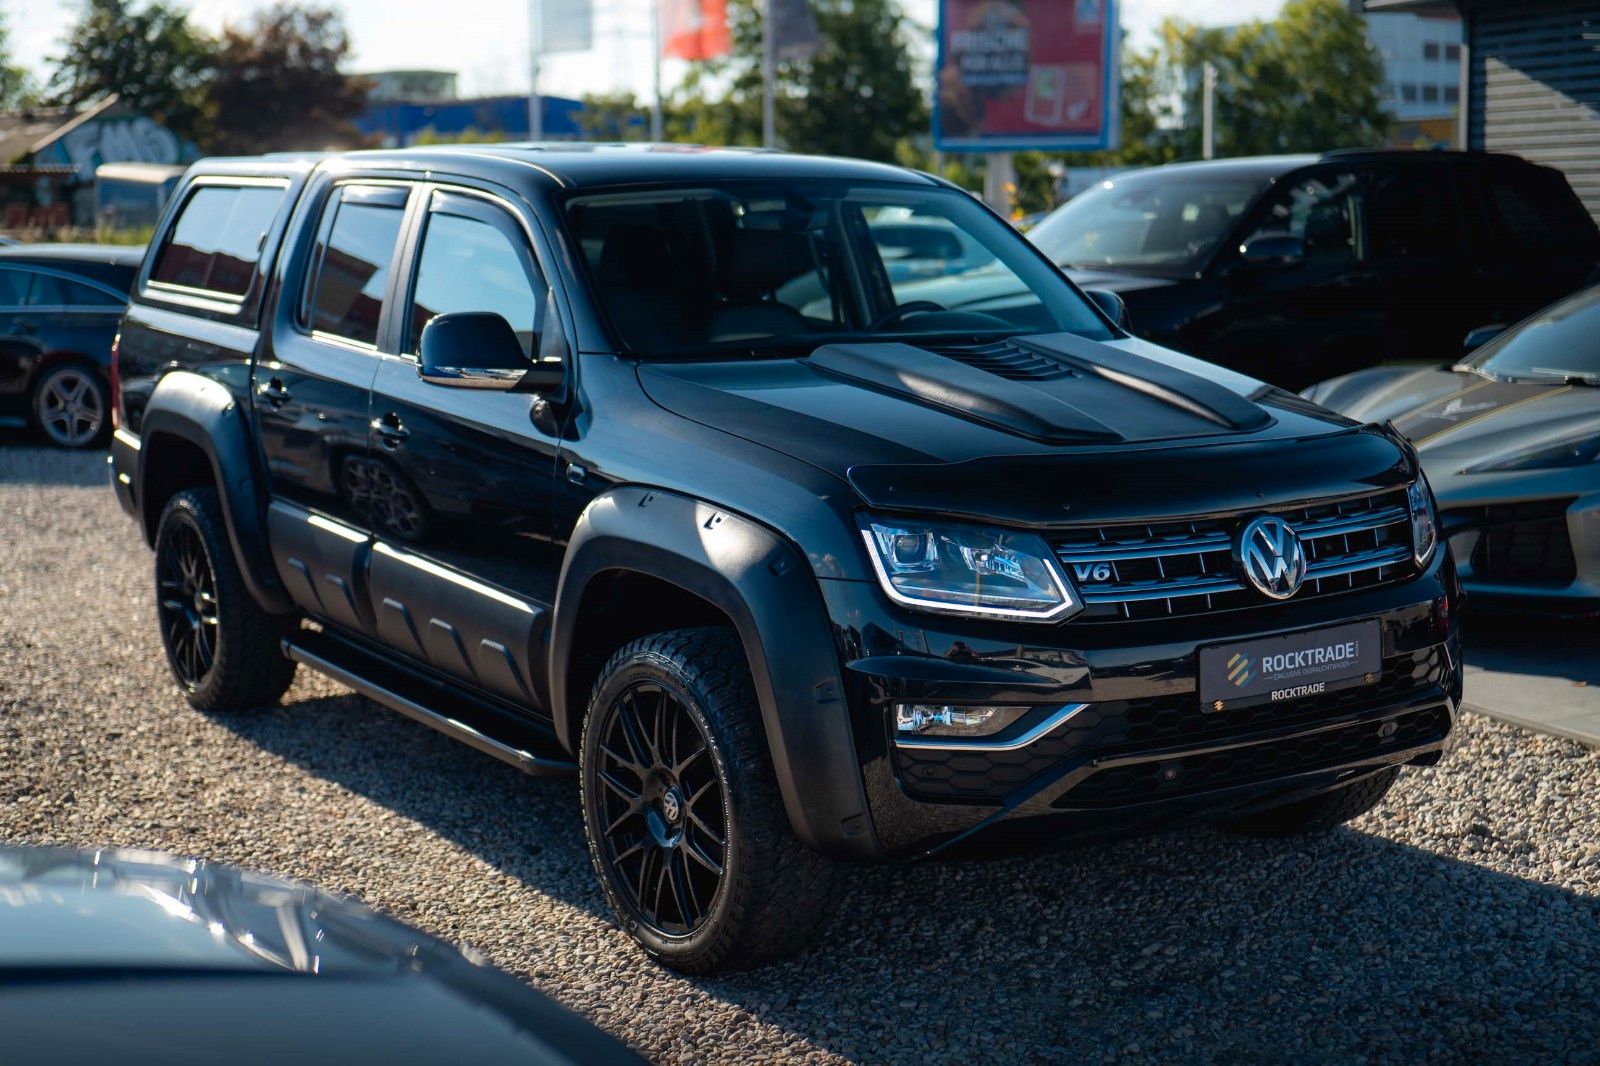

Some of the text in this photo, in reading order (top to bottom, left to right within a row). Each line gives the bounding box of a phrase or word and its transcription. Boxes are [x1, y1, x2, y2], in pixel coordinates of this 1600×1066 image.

[1240, 515, 1307, 600] VW
[1073, 563, 1110, 582] V6
[1262, 642, 1355, 673] ROCKTRADE
[1271, 682, 1325, 701] ROCKTRADE
